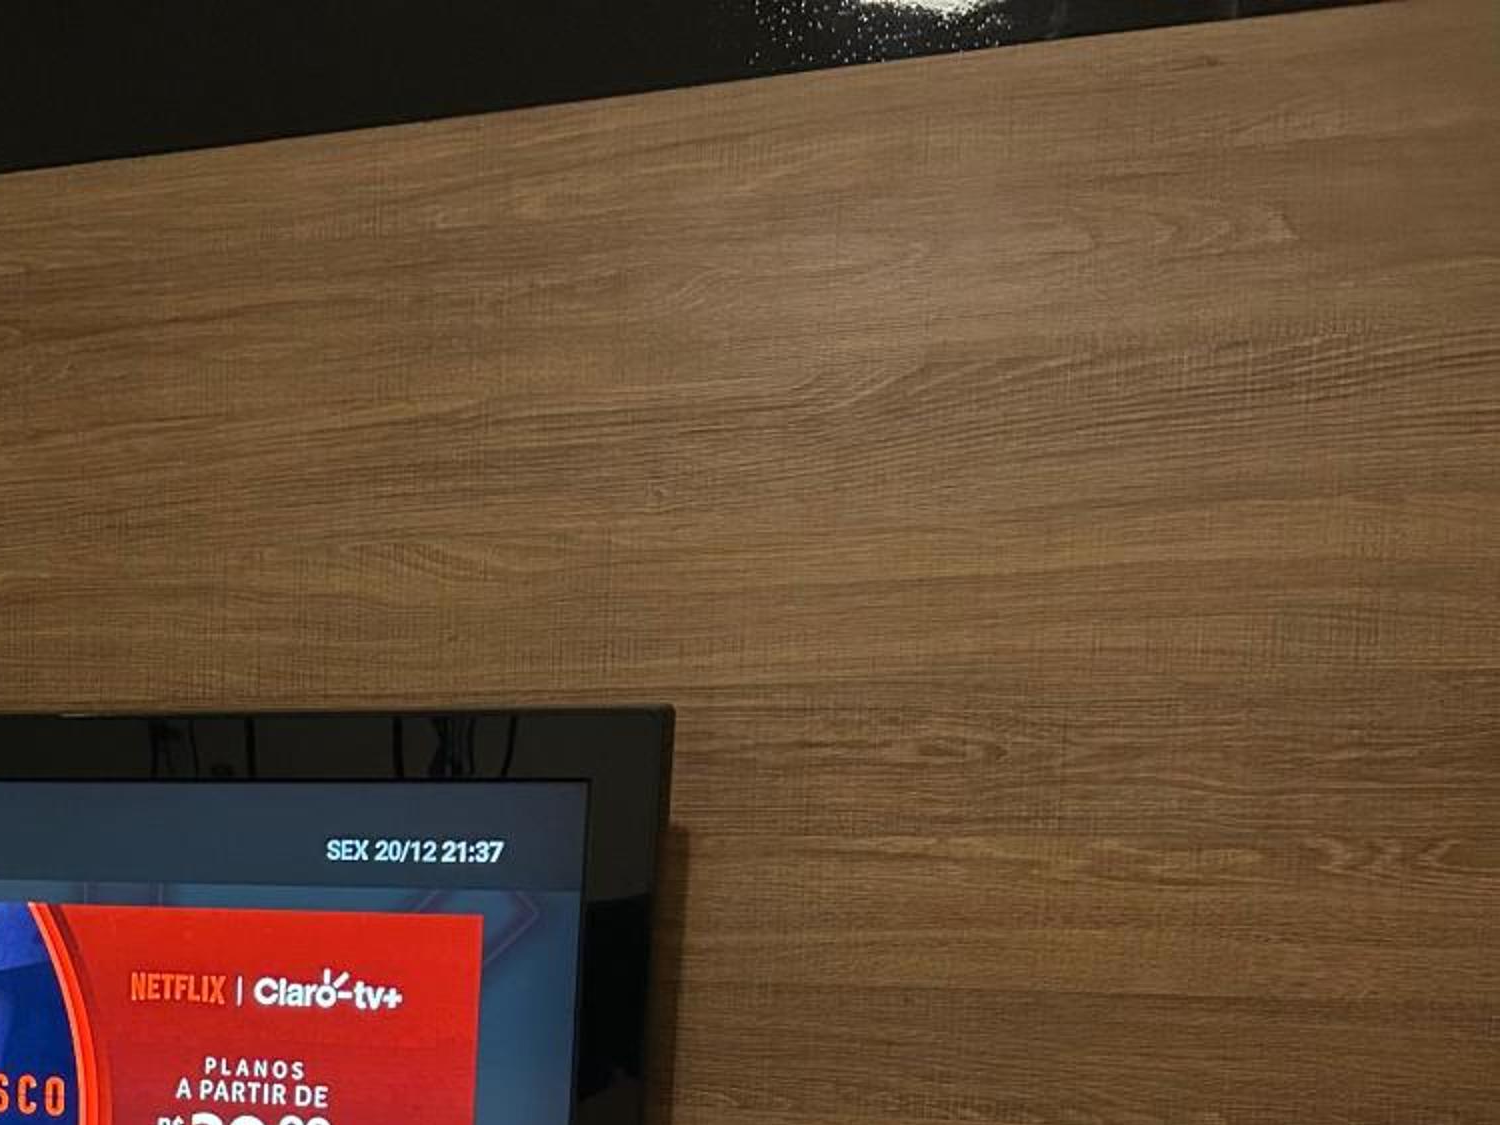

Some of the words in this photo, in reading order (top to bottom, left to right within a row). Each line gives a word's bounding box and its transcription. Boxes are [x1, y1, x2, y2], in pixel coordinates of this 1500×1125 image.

[326, 839, 369, 861] SEX
[375, 840, 437, 863] 20/12
[442, 840, 504, 863] 21:37
[131, 971, 226, 1005] NETFLIX
[254, 972, 339, 1006] Claro
[354, 981, 402, 1010] tv+
[205, 1056, 304, 1080] PLANOS
[175, 1077, 192, 1100] A
[200, 1080, 286, 1105] PARTIR
[295, 1086, 329, 1108] DE
